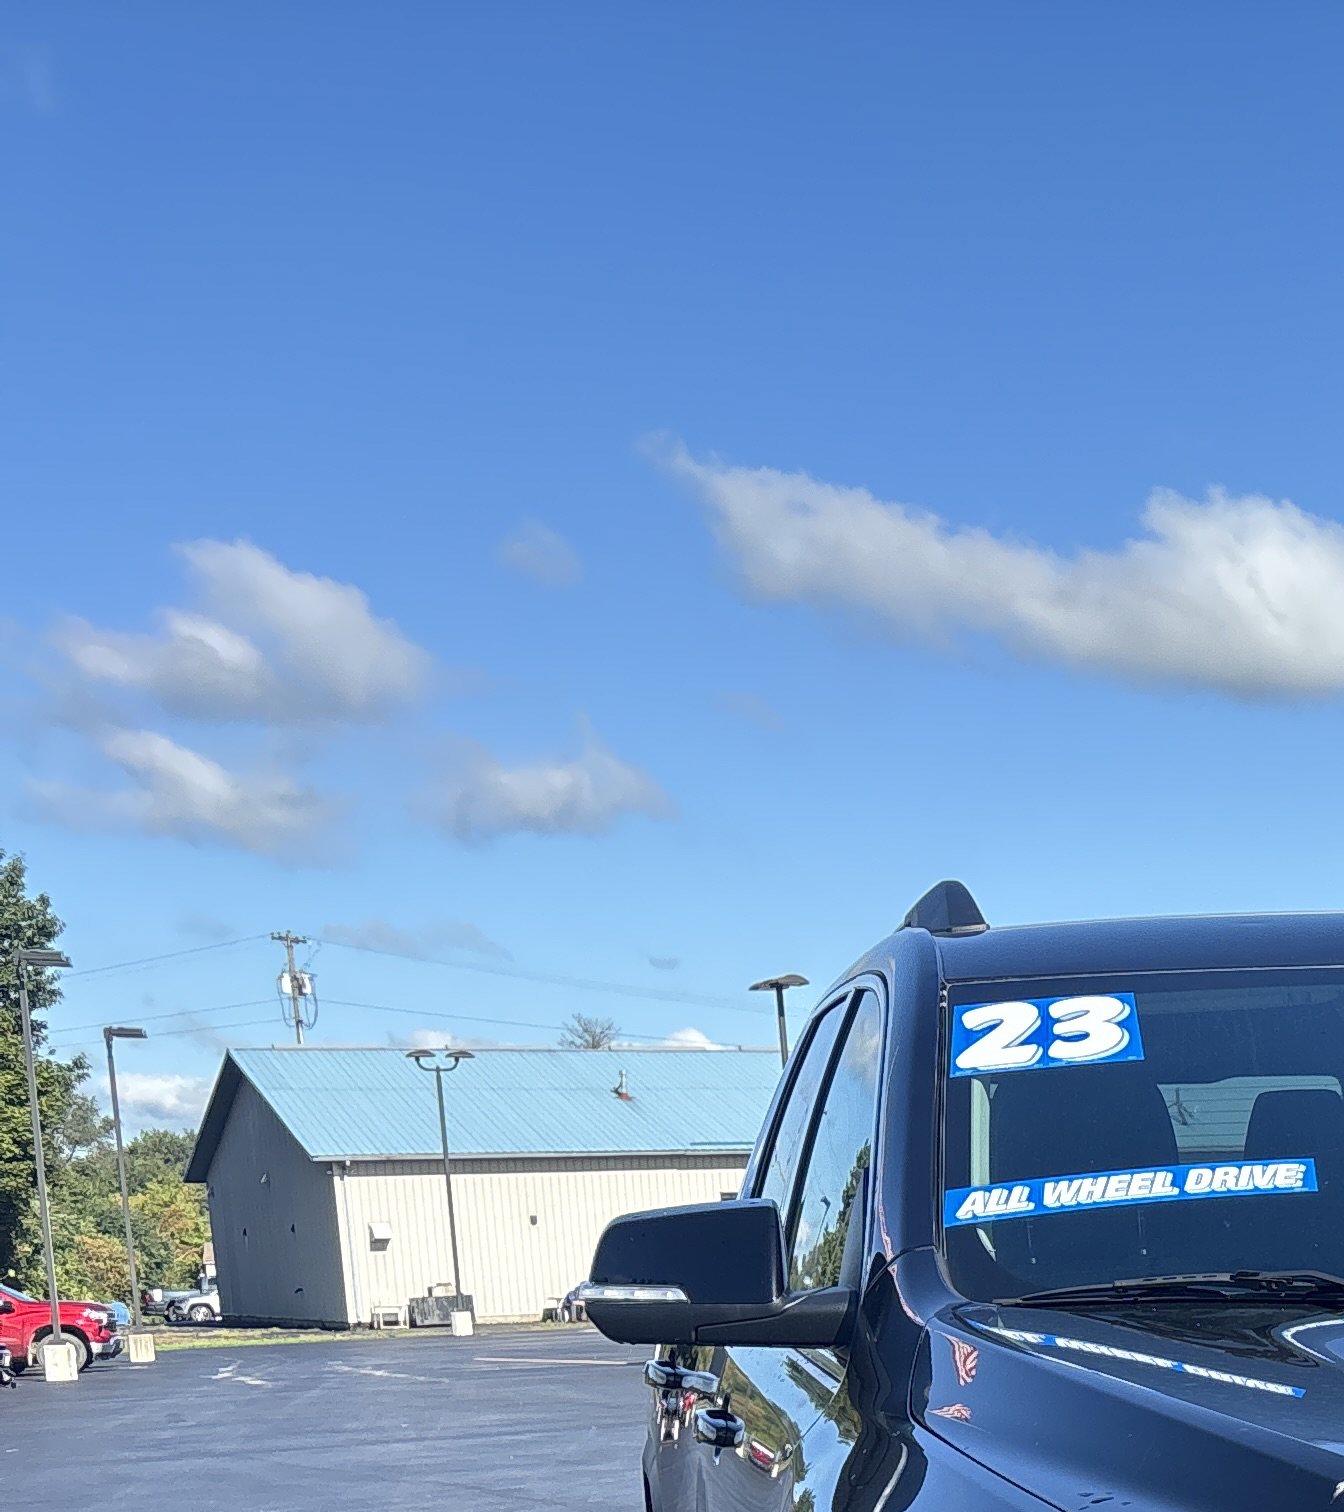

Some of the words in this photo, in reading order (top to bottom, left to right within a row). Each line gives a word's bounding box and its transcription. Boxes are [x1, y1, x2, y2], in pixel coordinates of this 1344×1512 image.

[955, 995, 1130, 1070] 23
[955, 1185, 1035, 1220] ALL
[1043, 1171, 1179, 1208] WHEEL
[1184, 1162, 1308, 1194] DRIVE
